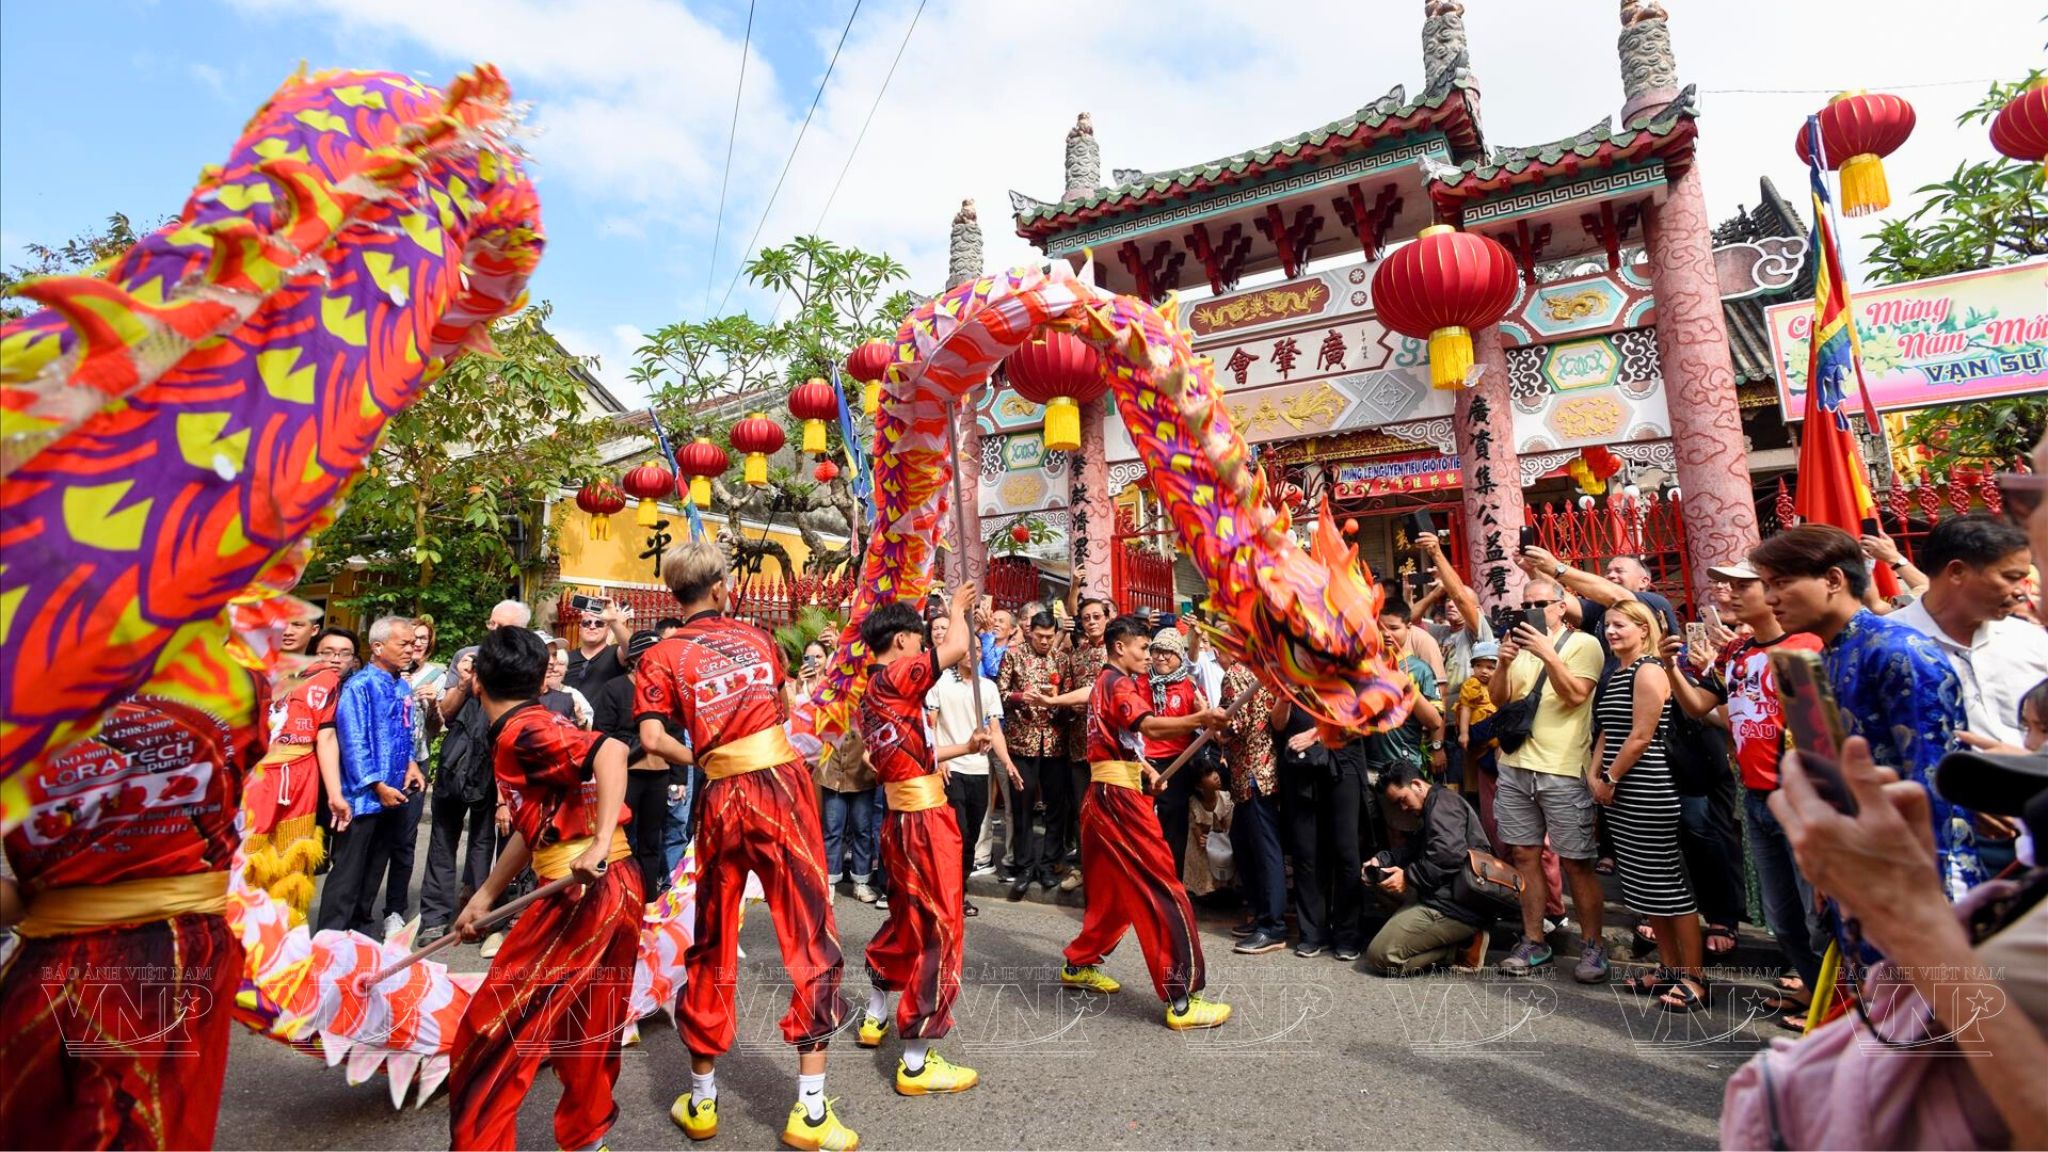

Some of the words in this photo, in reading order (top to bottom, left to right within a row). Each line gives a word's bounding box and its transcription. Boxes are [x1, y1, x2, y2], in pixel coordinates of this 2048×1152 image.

[1866, 298, 1949, 325] Mừng
[1897, 330, 1966, 359] Năm
[1985, 315, 2048, 346] Mới
[1925, 358, 1989, 383] VẠN
[2000, 348, 2042, 373] SỰ
[695, 650, 761, 674] LORATECH
[40, 740, 195, 789] LORATECH
[147, 755, 192, 773] pump
